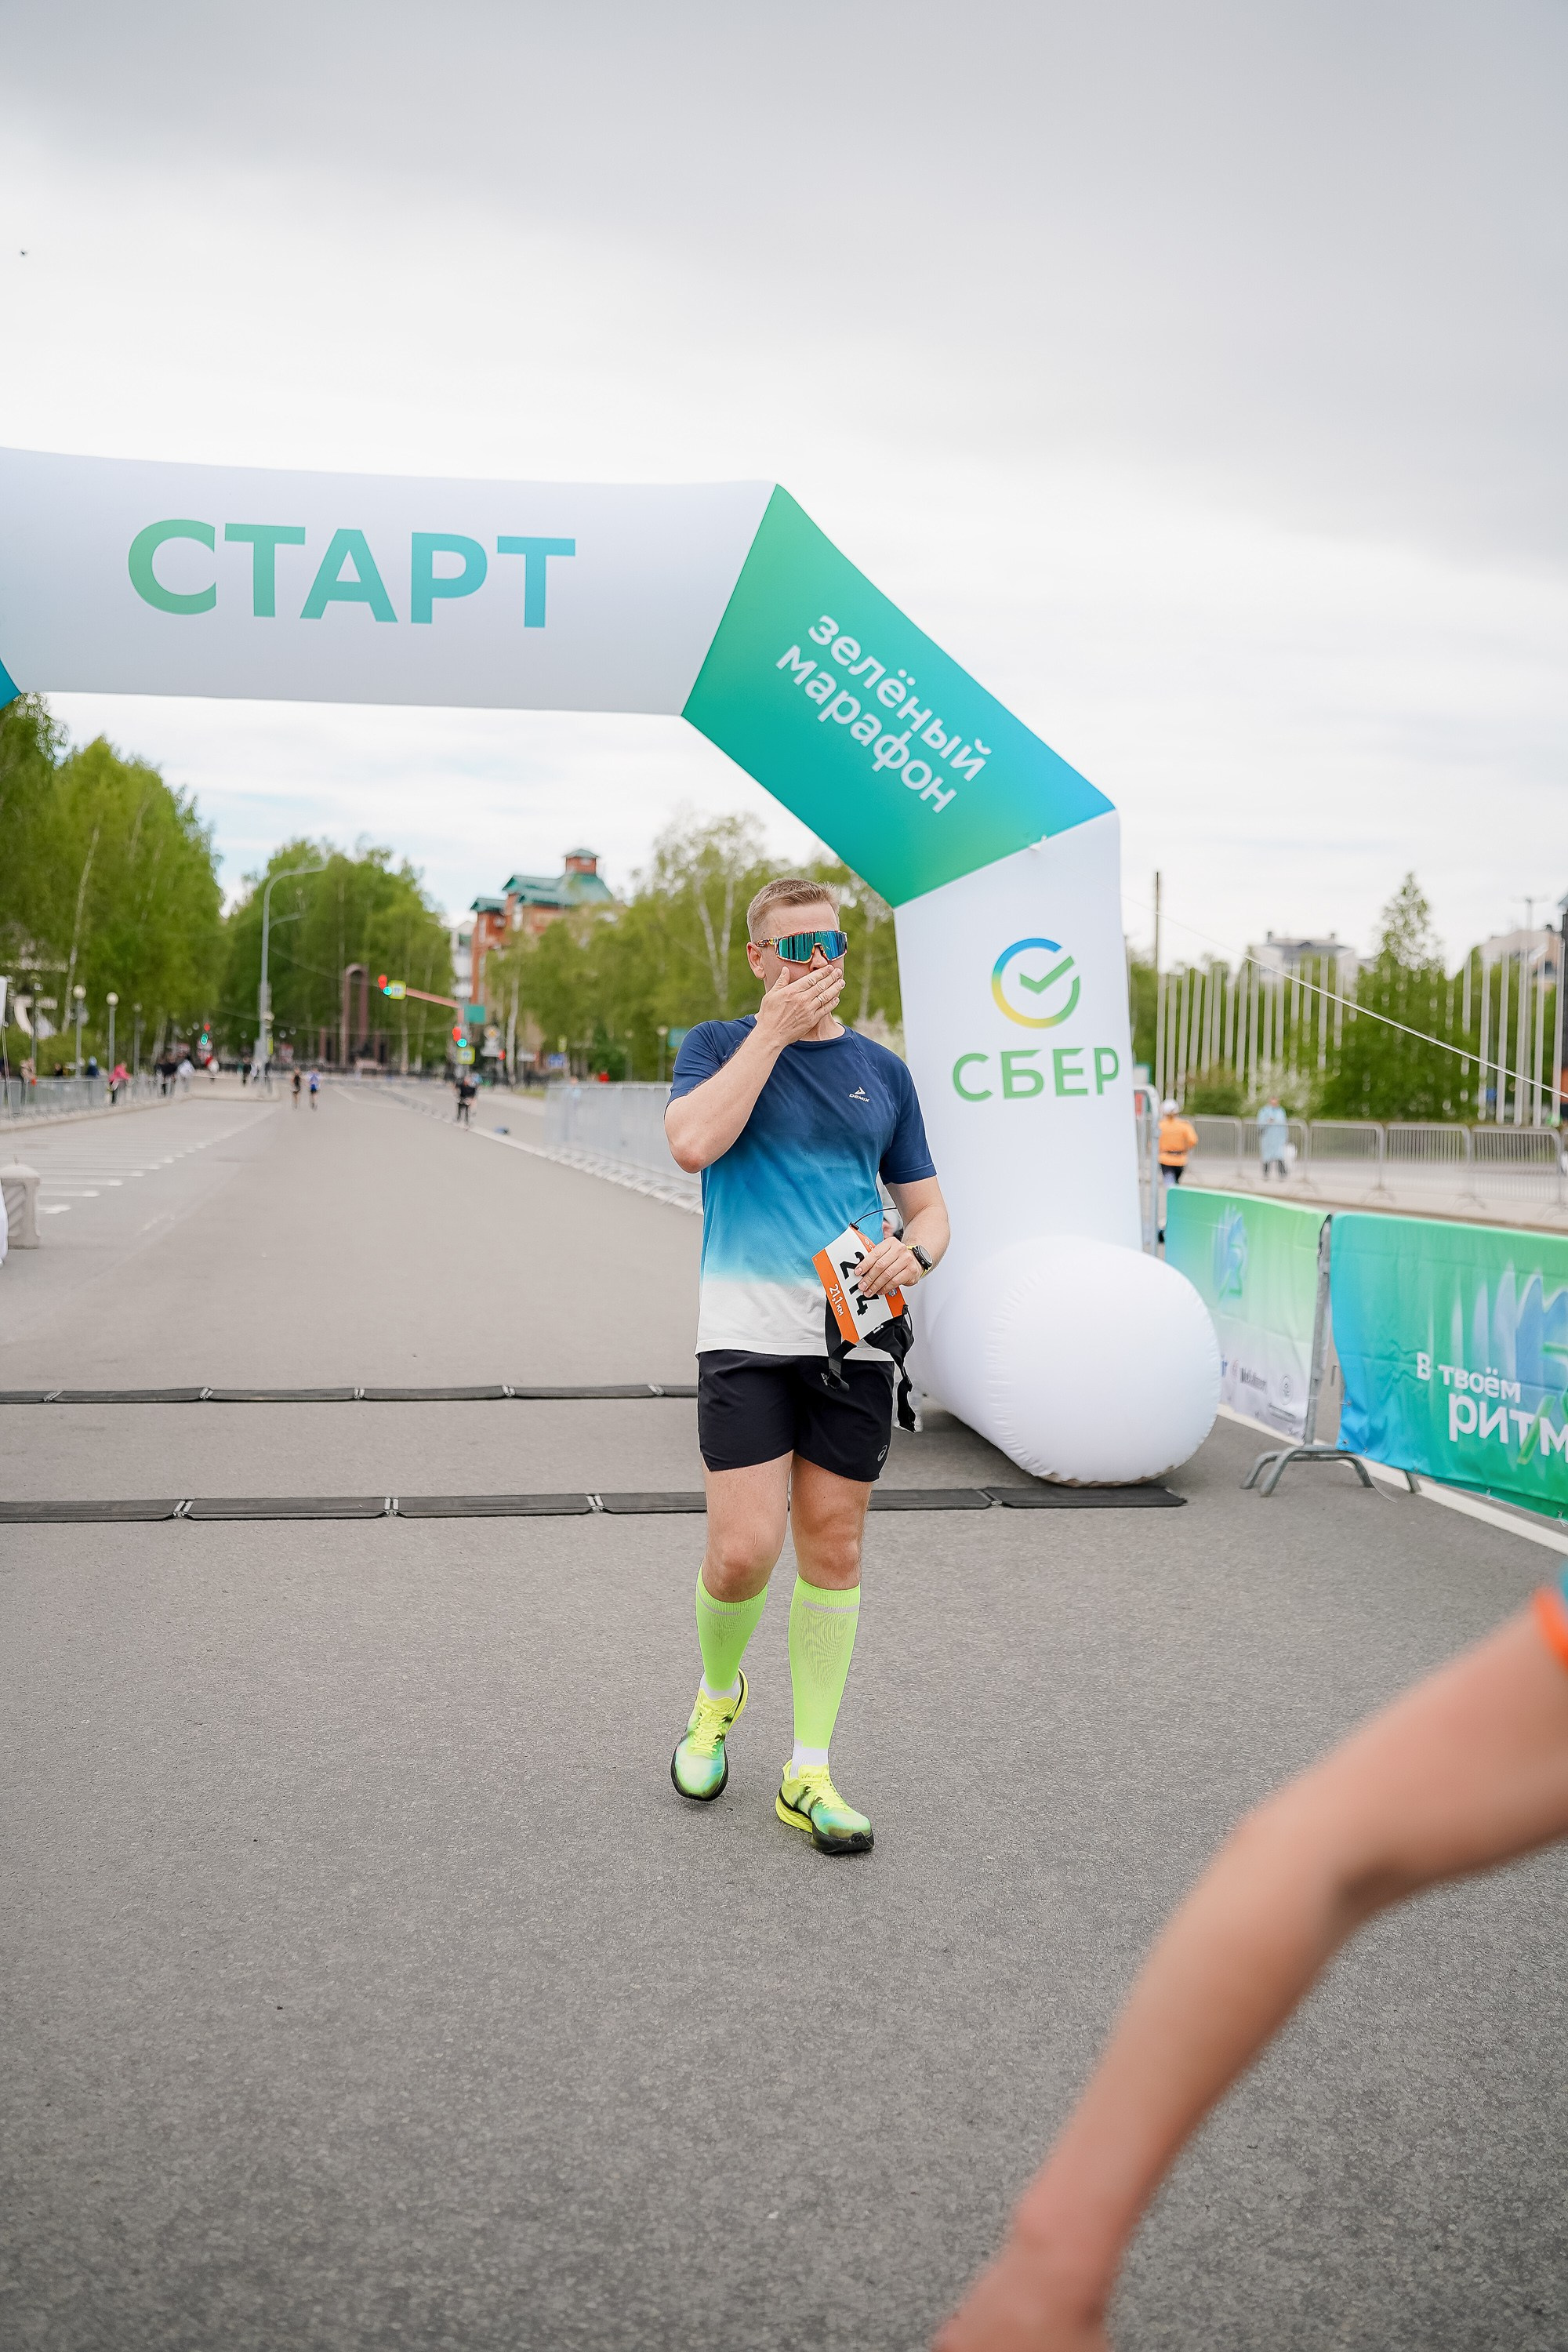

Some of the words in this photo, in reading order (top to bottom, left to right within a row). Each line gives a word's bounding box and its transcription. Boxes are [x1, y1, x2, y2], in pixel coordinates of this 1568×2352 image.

[129, 519, 575, 628] СТАРТ
[775, 644, 957, 814] марафон
[808, 615, 993, 782] зелёный
[848, 1094, 870, 1103] DEMIX
[953, 1047, 1120, 1102] СБЕР
[1437, 1364, 1521, 1403] твоём
[1449, 1392, 1568, 1464] ритм
